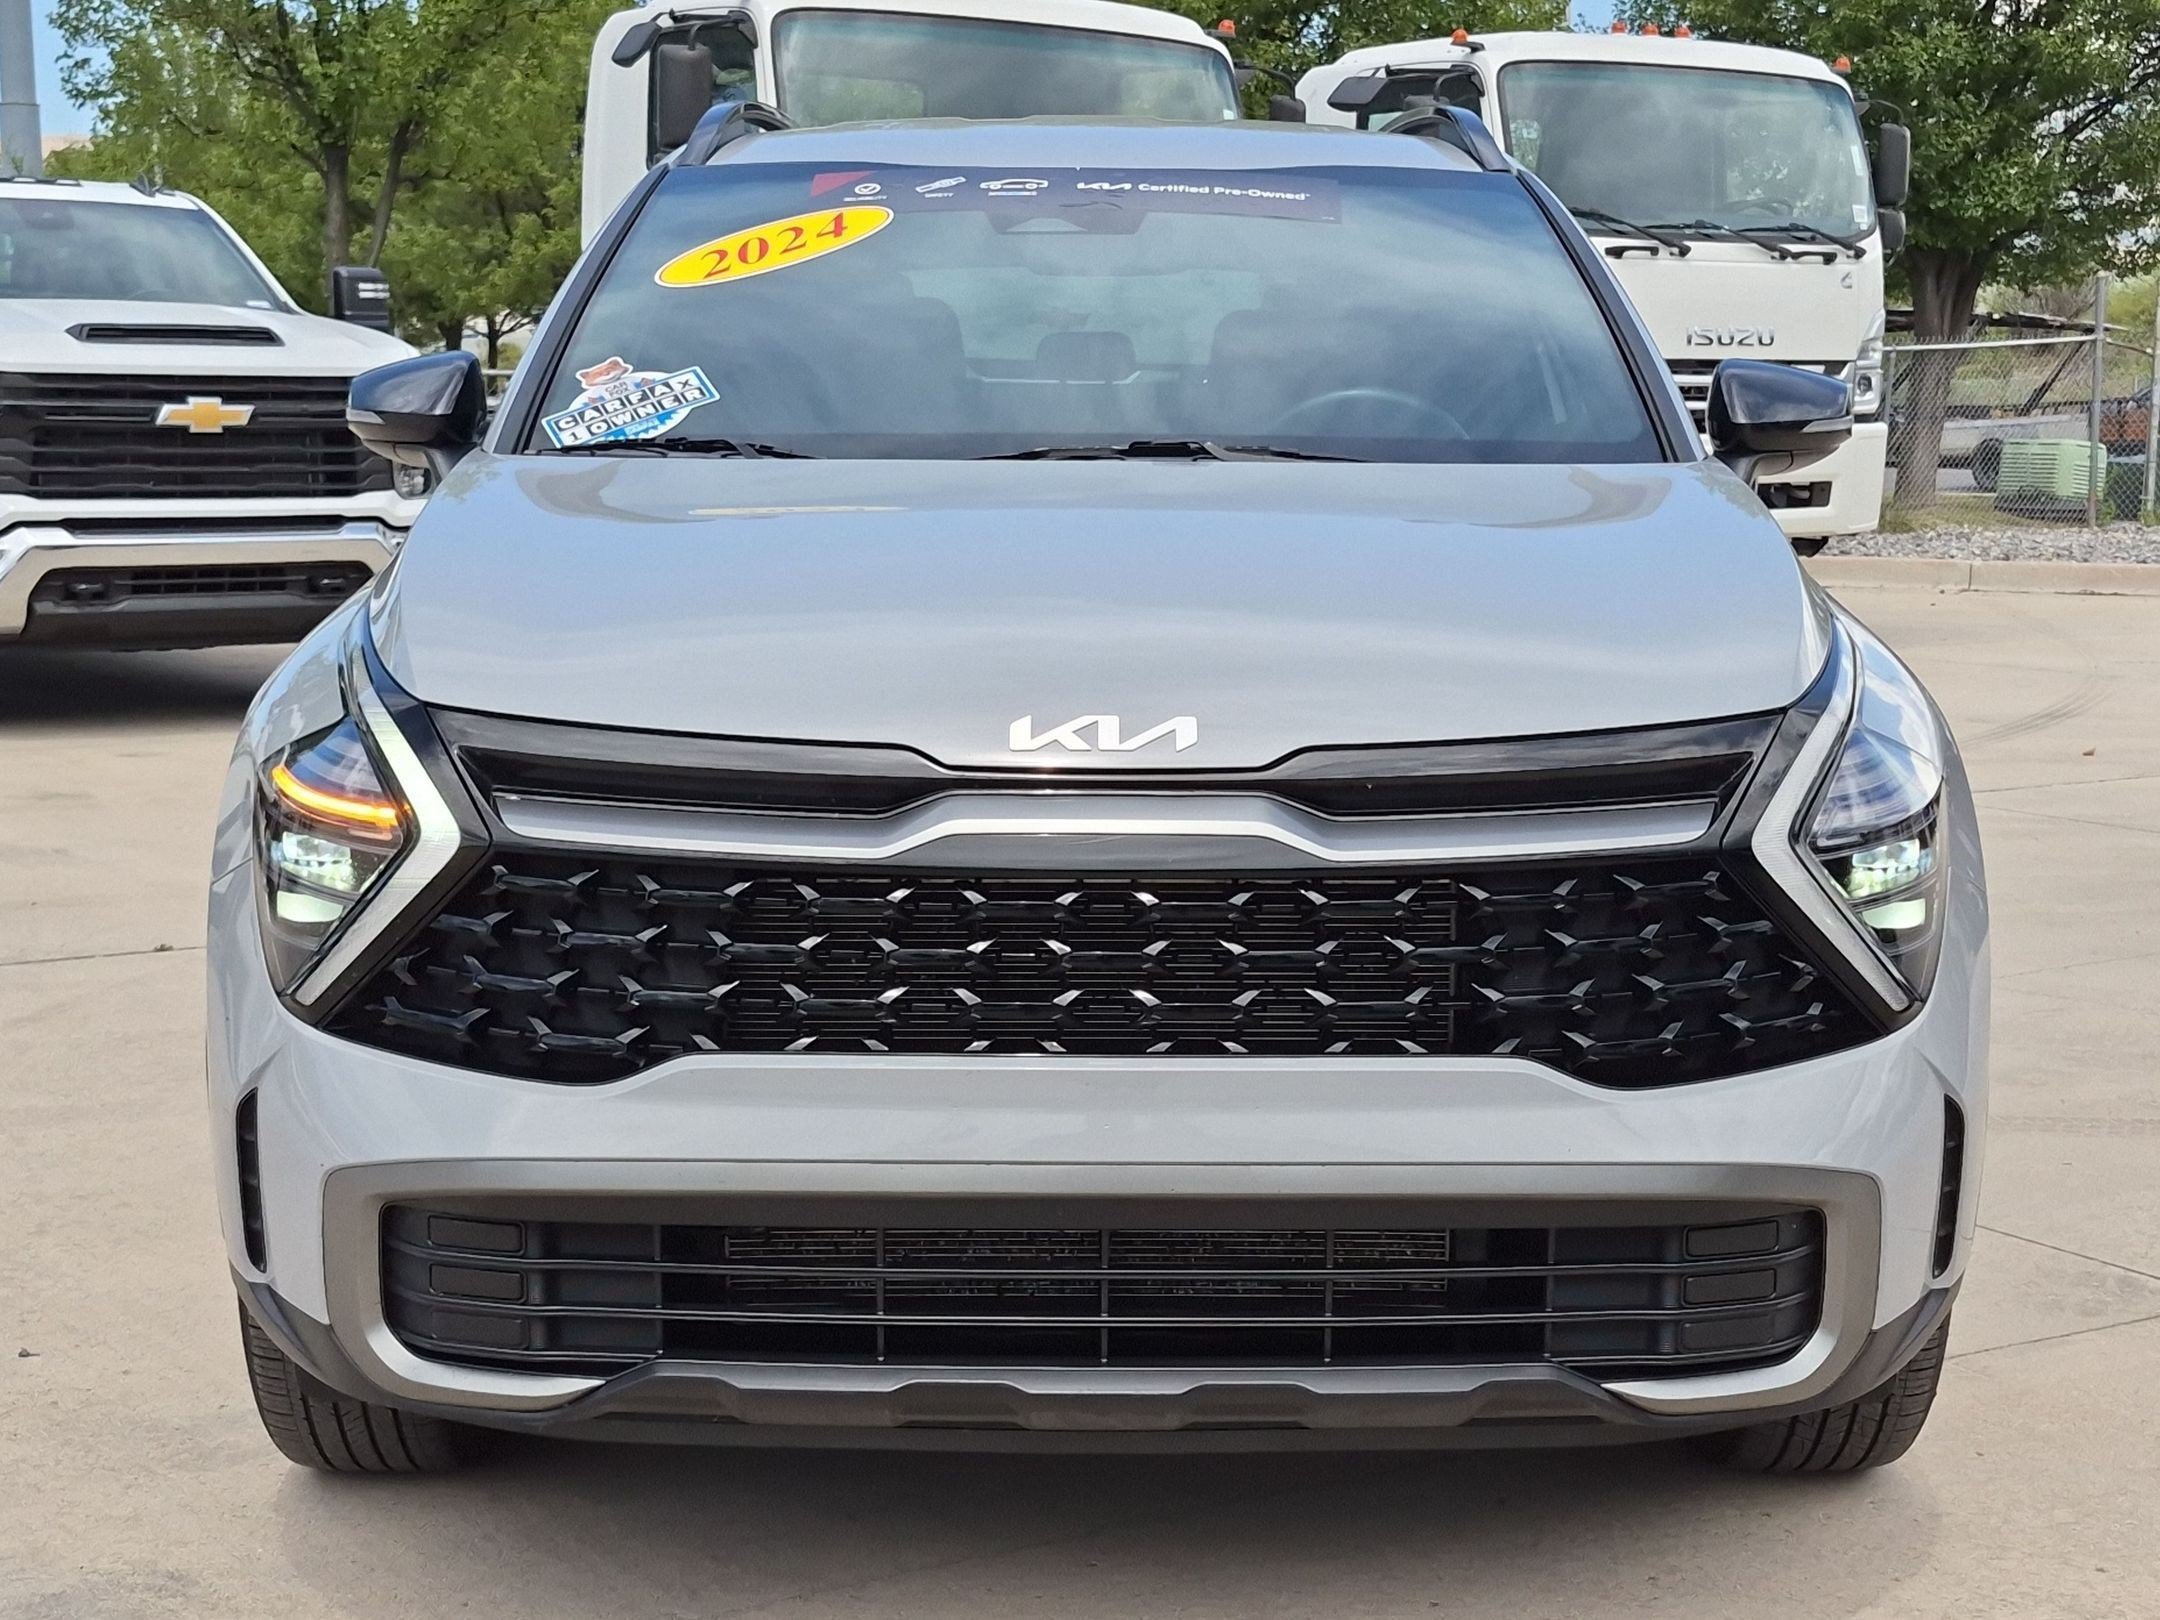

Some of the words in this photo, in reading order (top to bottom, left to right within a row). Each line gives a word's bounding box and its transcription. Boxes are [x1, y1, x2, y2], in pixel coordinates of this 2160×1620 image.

[1138, 183, 1210, 194] Certified
[700, 212, 848, 280] 2024
[1686, 326, 1775, 347] ISUZU
[557, 379, 694, 430] CARFAX
[570, 431, 583, 442] 1
[589, 389, 702, 434] OWNER
[1009, 714, 1198, 752] KIA
